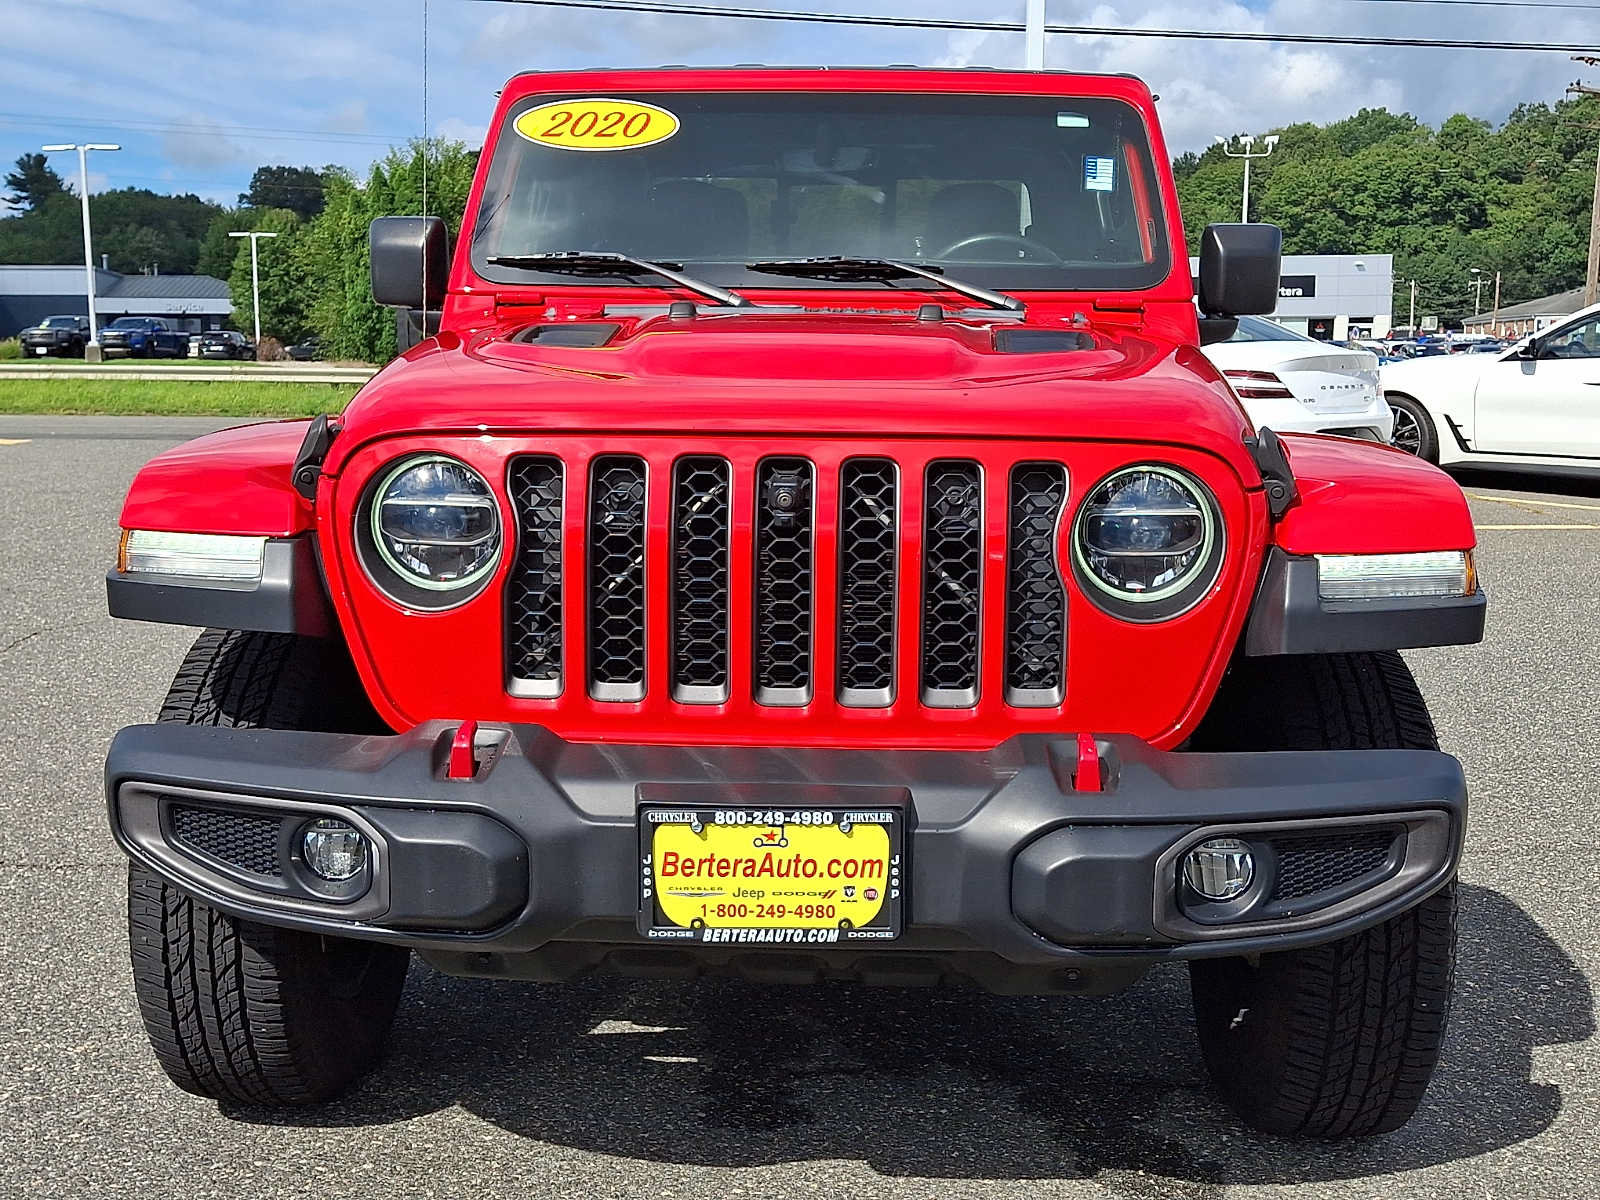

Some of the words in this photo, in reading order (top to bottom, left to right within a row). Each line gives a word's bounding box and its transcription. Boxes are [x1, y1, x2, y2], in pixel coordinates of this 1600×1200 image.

[541, 111, 651, 138] 2020
[166, 303, 205, 312] Service
[648, 812, 698, 823] CHRYSLER
[714, 811, 834, 825] 800-249-4980
[843, 812, 894, 823] CHRYSLER
[661, 852, 884, 879] BerteraAuto.com
[642, 854, 652, 899] Jeep
[890, 855, 900, 899] Jeep
[732, 887, 765, 900] Jeep
[700, 903, 835, 919] 1-800-249-4980
[648, 930, 694, 938] DODGE
[702, 928, 840, 943] BERTERAAUTO.COM
